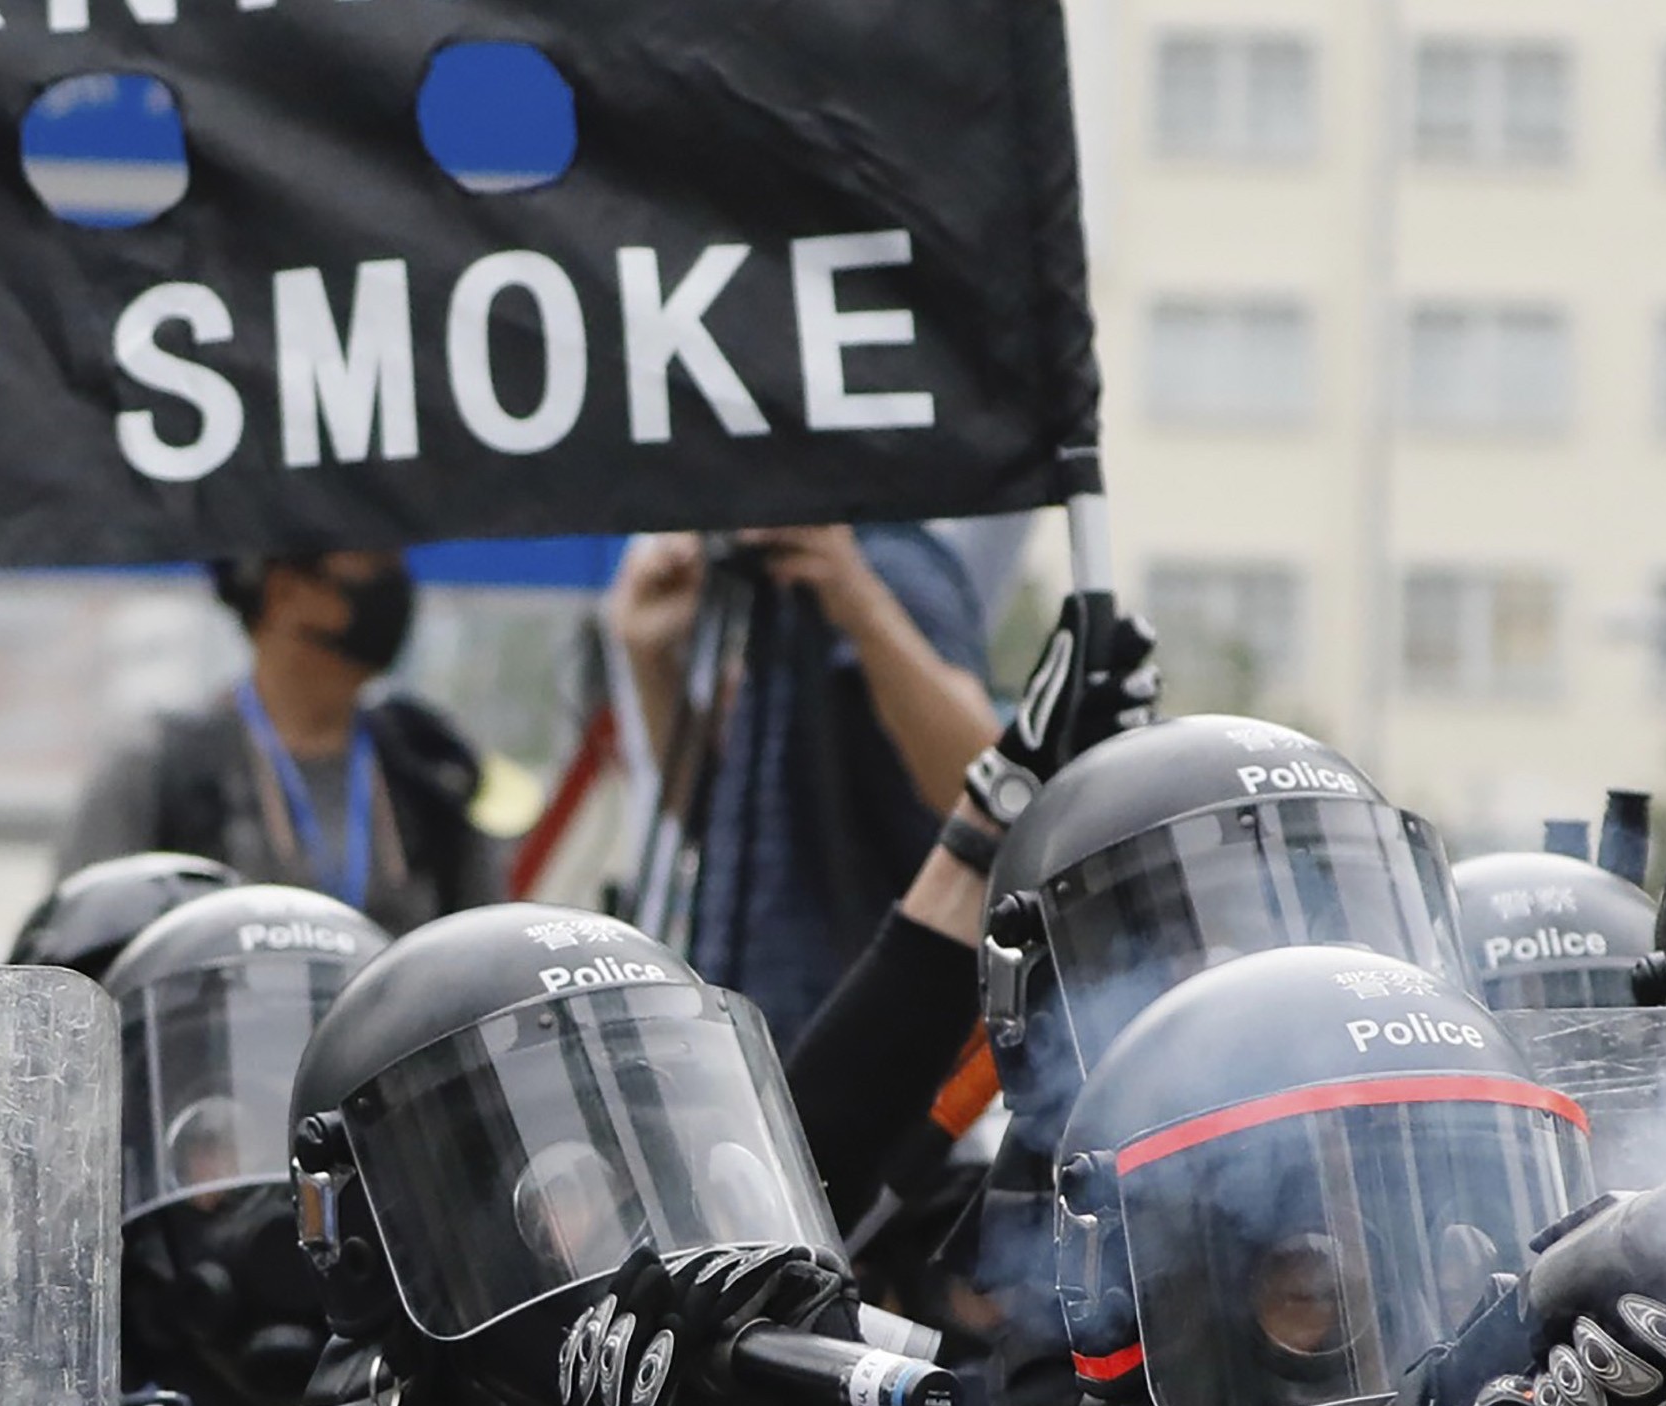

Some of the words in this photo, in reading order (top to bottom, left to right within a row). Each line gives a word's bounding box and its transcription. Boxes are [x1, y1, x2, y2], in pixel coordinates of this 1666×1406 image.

[114, 229, 935, 482] SMOKE
[1236, 760, 1358, 794] Police
[238, 920, 355, 955] Police
[1484, 926, 1607, 970] Police
[538, 956, 667, 993] Police
[1346, 1012, 1485, 1053] Police
